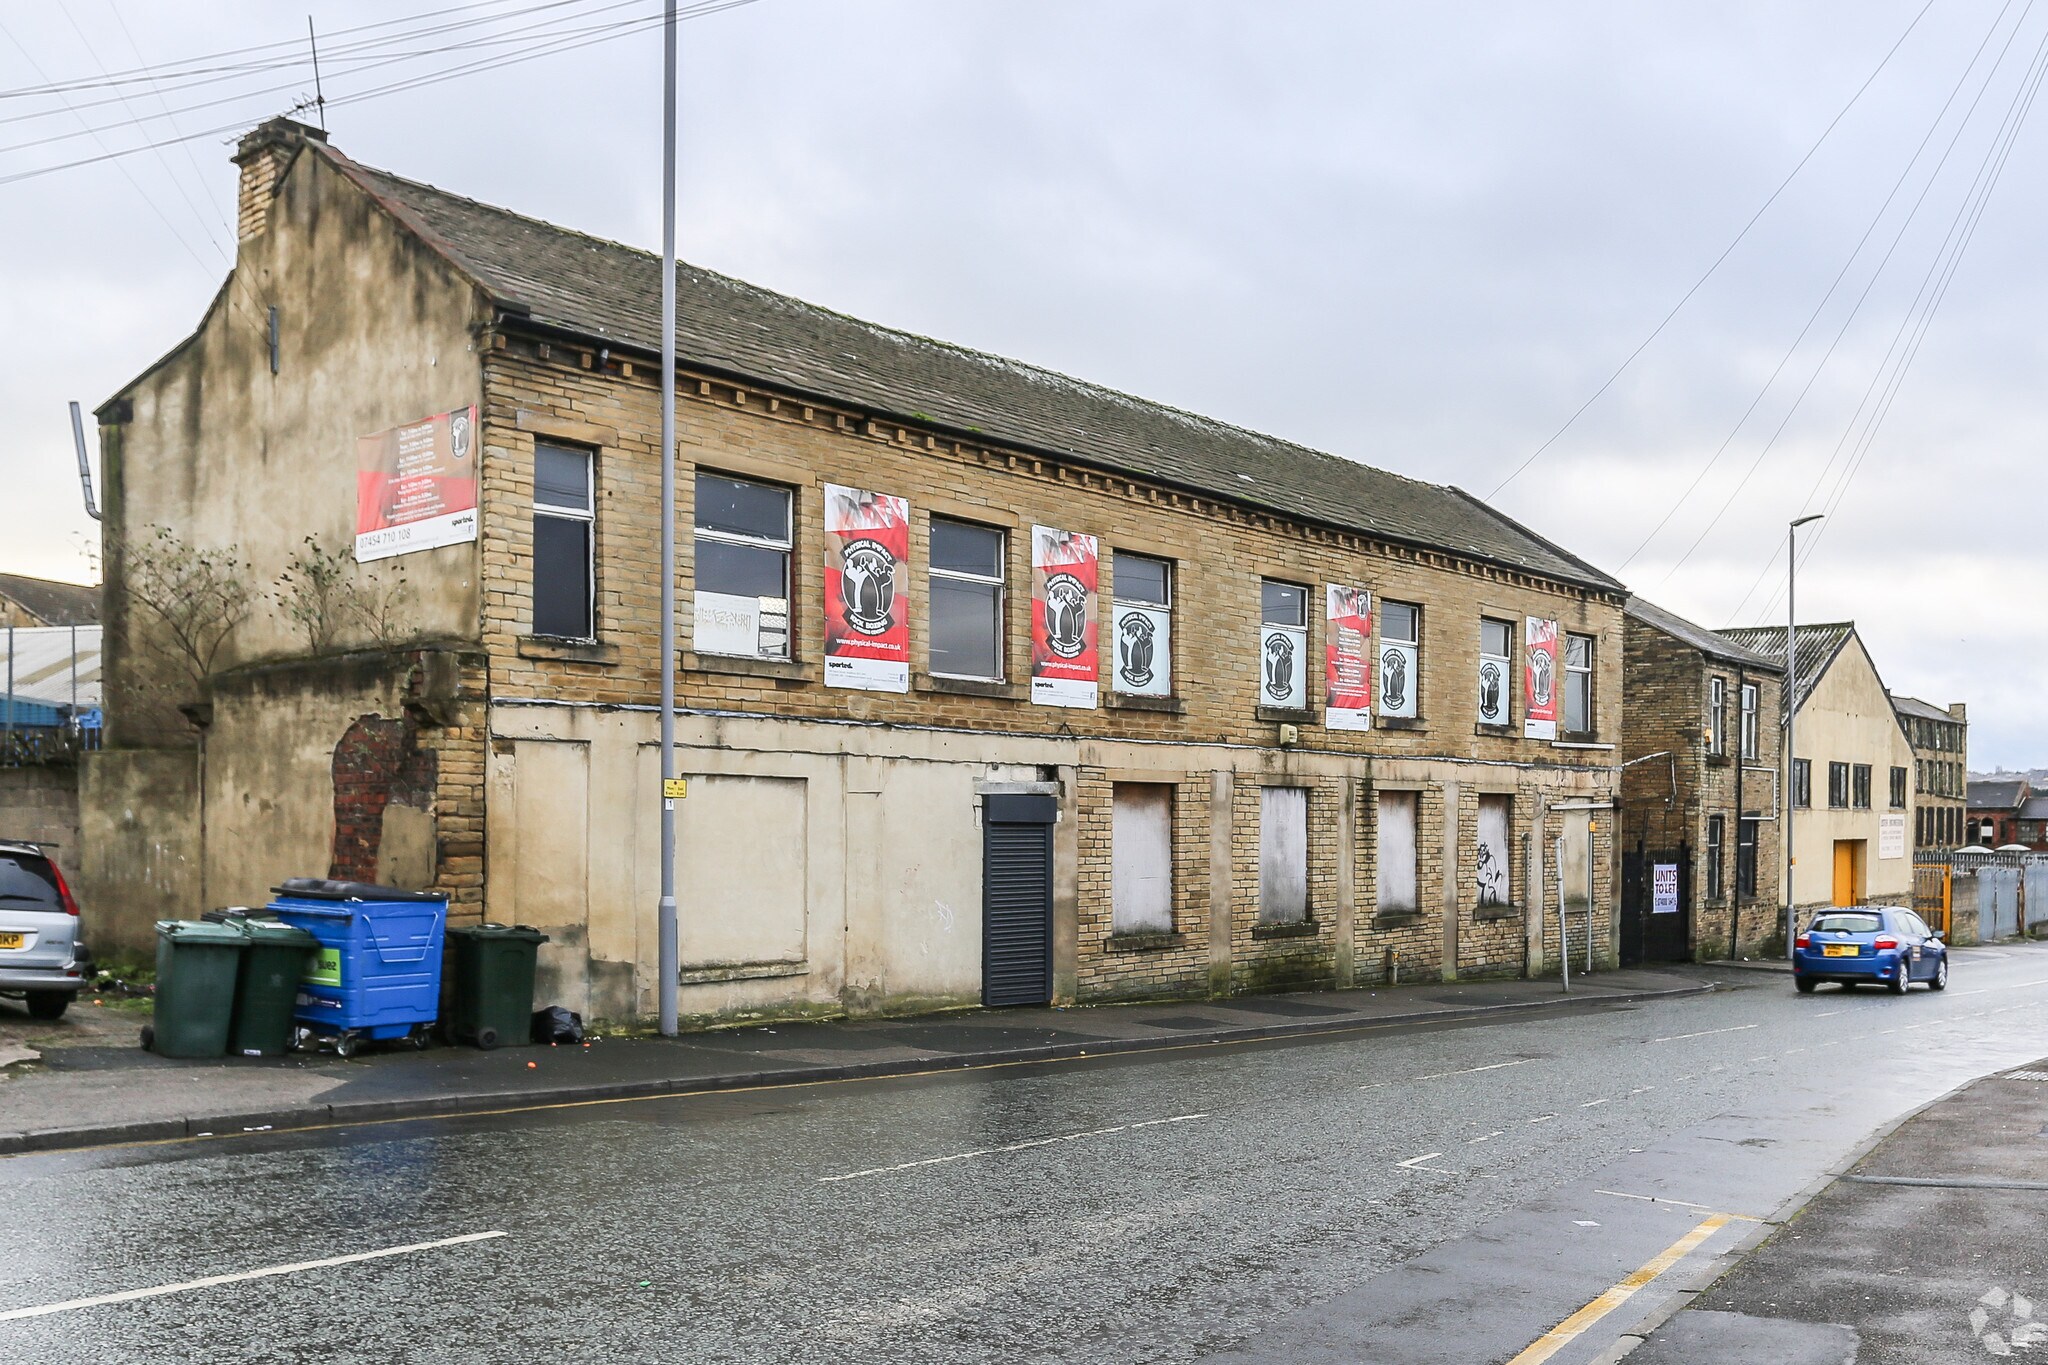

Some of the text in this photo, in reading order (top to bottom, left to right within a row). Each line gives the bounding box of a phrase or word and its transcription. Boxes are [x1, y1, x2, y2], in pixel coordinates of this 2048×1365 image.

[383, 531, 395, 545] 710
[399, 528, 411, 540] 108
[844, 540, 893, 562] PHYSICAL IMPACT
[865, 618, 888, 629] BOXING
[836, 638, 901, 651] www.physical-impact.co.uk
[1655, 870, 1676, 882] UNITS
[1655, 883, 1675, 894] TO LET
